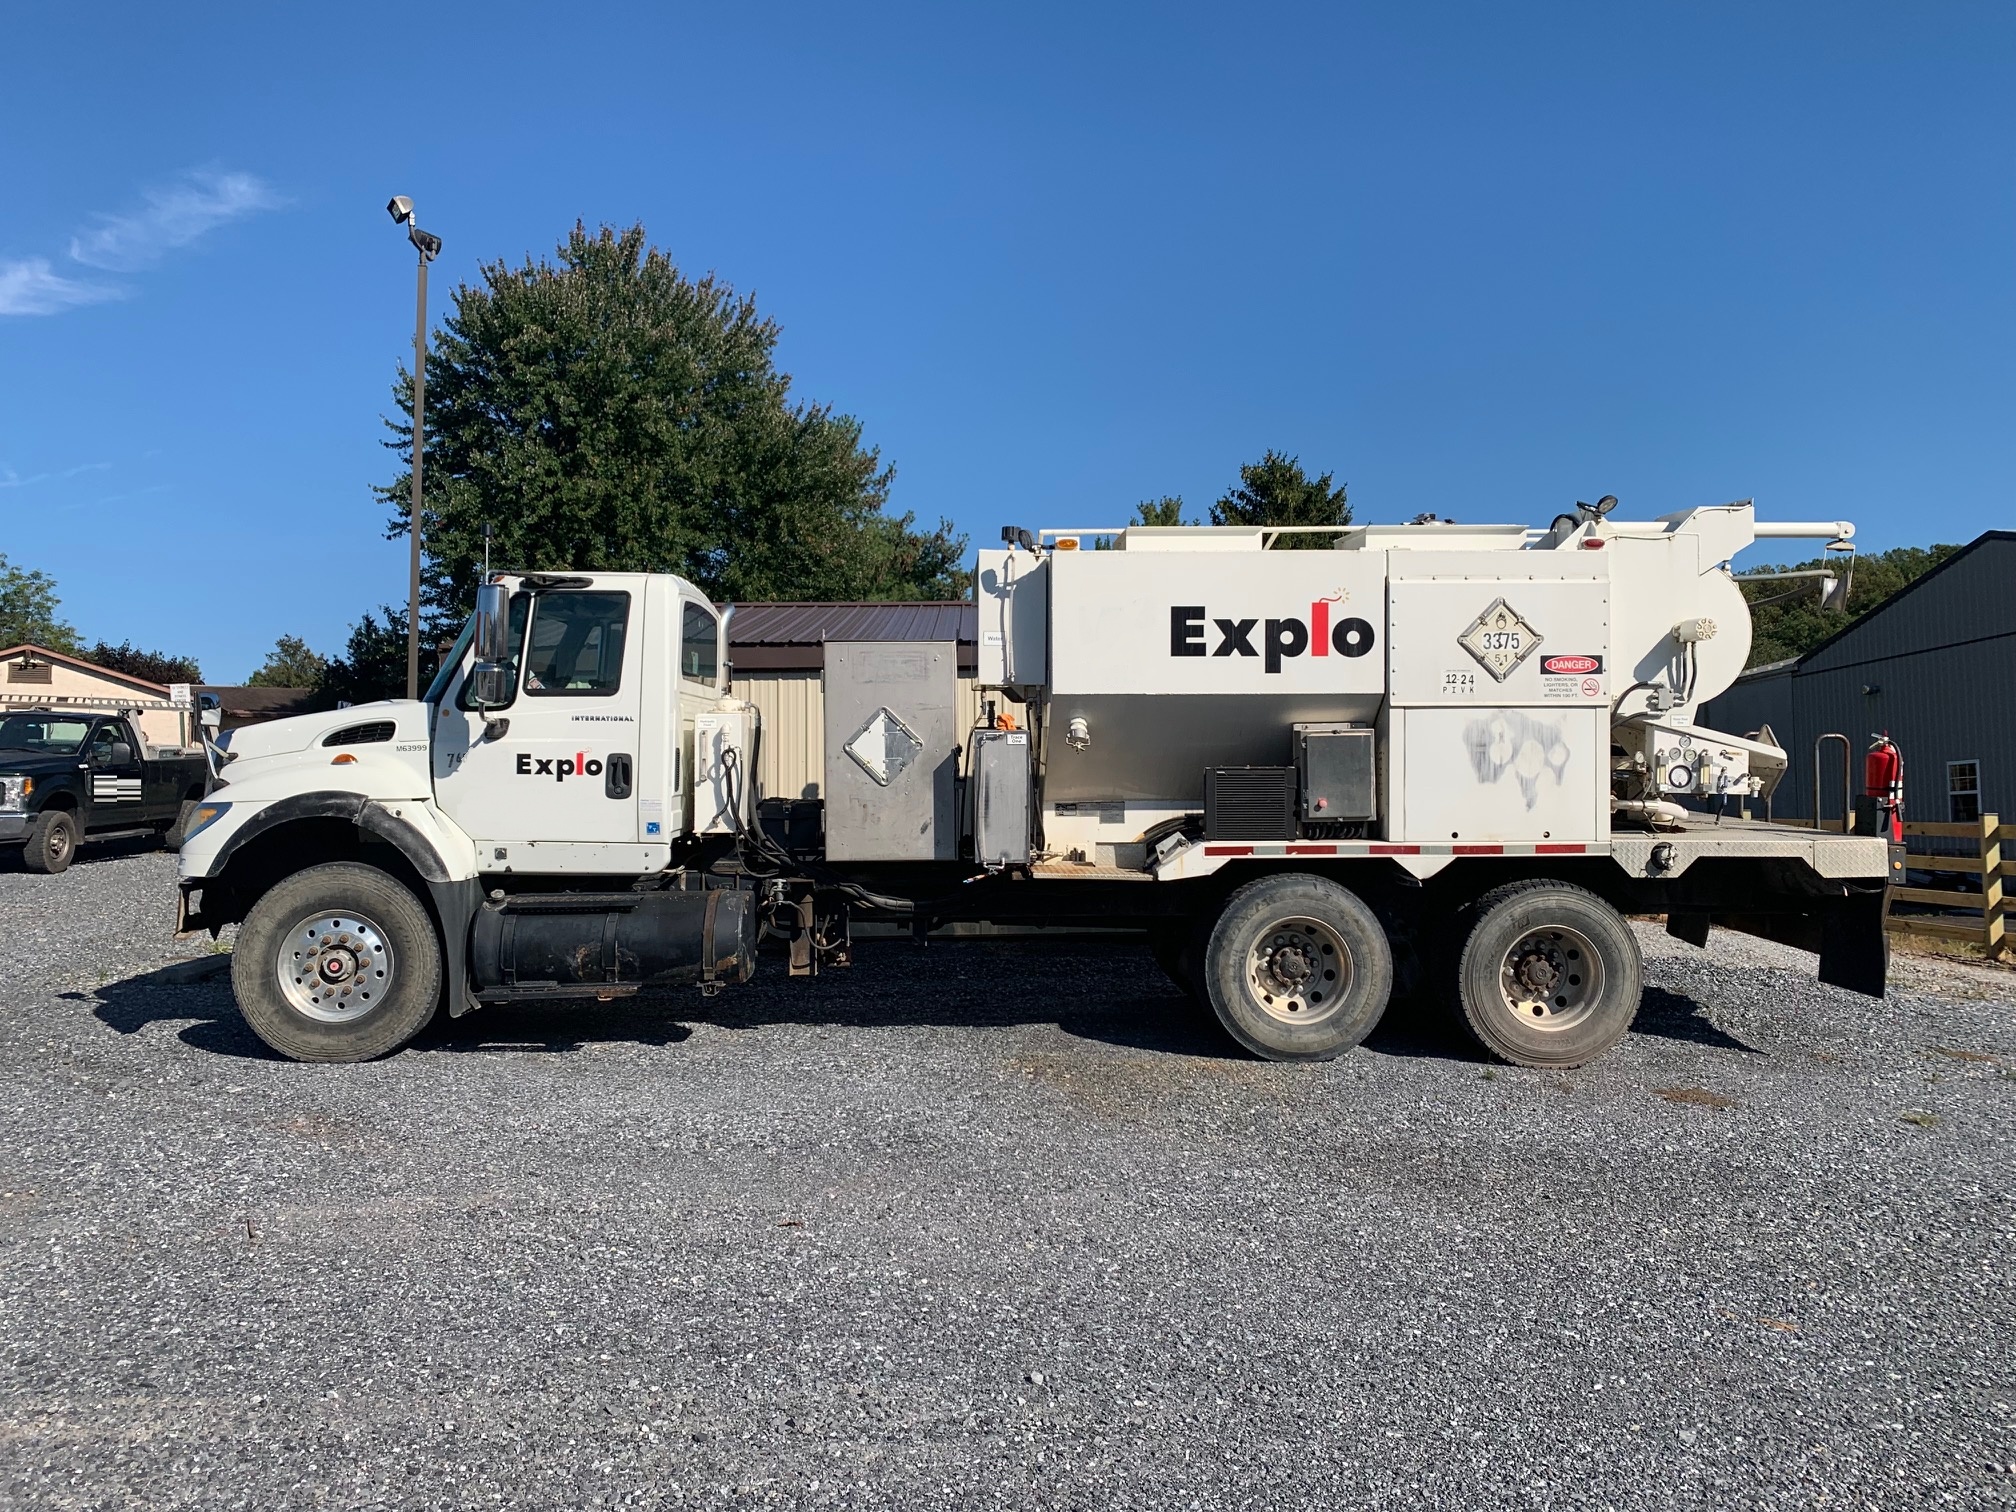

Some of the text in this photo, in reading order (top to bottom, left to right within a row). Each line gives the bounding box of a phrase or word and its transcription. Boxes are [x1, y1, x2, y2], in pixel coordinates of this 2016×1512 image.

[1170, 602, 1375, 674] Explo
[1483, 632, 1520, 650] 3375
[1551, 660, 1592, 669] DANGER
[516, 752, 603, 782] Explo
